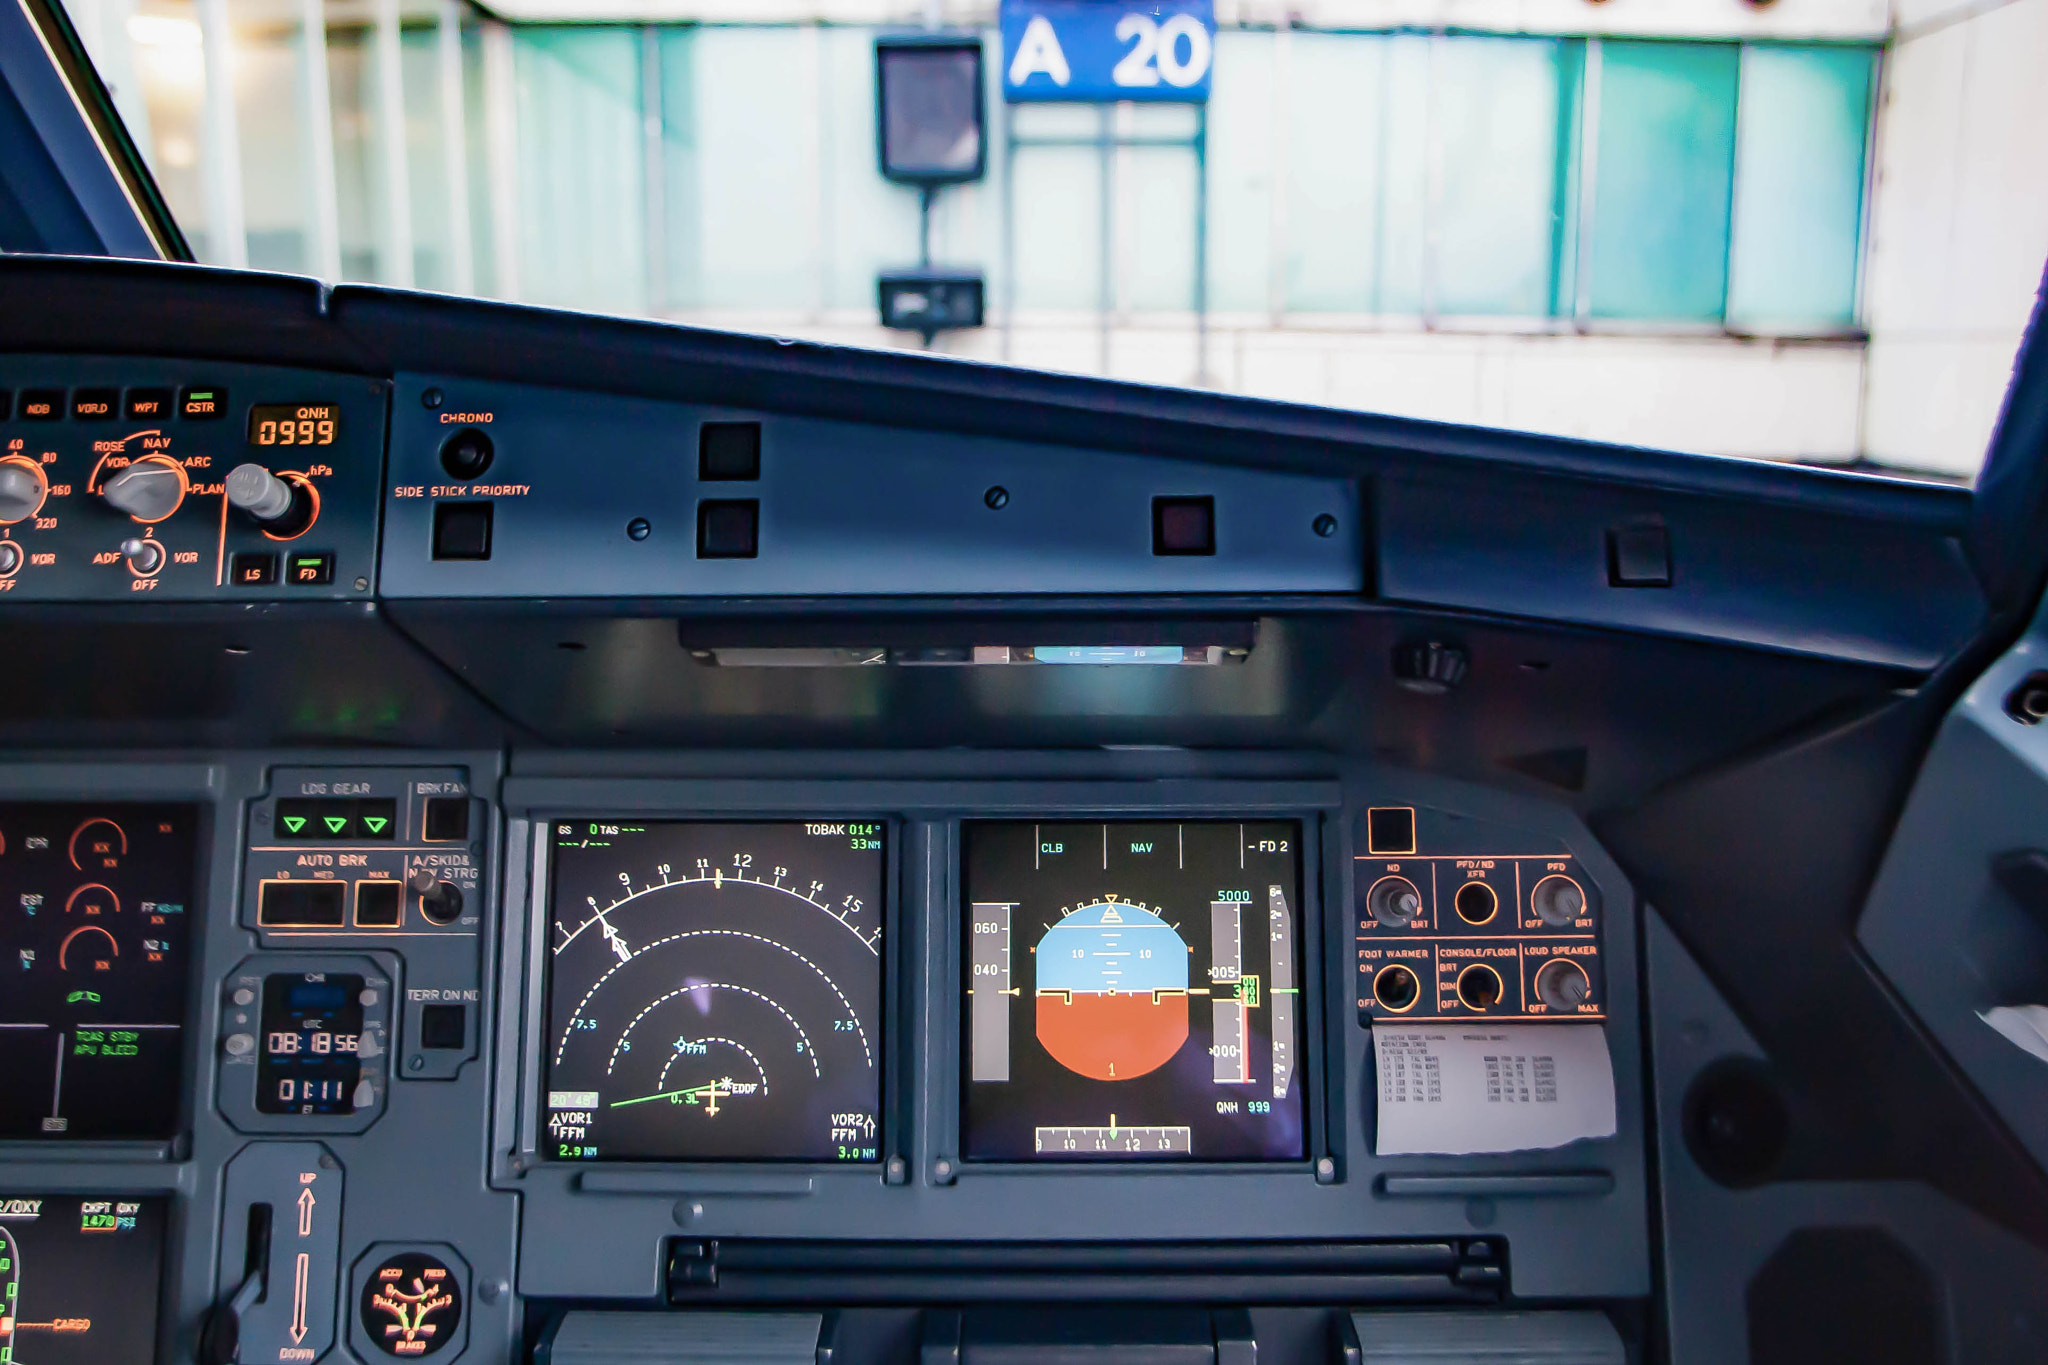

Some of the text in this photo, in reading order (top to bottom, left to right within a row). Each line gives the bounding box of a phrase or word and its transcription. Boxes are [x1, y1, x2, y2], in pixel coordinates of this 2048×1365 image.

[1009, 14, 1212, 87] A 20
[133, 402, 158, 412] WPT
[185, 402, 215, 413] CSTR
[297, 408, 329, 420] QNH
[440, 412, 494, 424] CHRONO
[259, 421, 334, 445] 0999
[8, 439, 23, 449] 40
[94, 441, 125, 451] ROSE
[143, 438, 171, 448] NAV
[106, 458, 129, 468] VOR
[184, 457, 211, 467] ARC
[310, 464, 333, 476] hPa
[51, 485, 71, 495] 160
[192, 484, 225, 494] PLAN
[394, 485, 531, 498] SIDE STICK PRIORITY
[35, 518, 57, 529] 320
[145, 527, 153, 538] 2
[31, 553, 55, 565] VOR
[92, 552, 122, 564] ADF
[174, 552, 199, 563] VOR
[246, 569, 261, 581] LS
[300, 569, 317, 580] FD
[131, 579, 158, 591] OFF
[301, 783, 370, 795] LDG GEAR
[417, 782, 441, 794] BRK
[600, 825, 619, 835] TAS
[805, 824, 845, 835] TOBAK
[1041, 843, 1063, 853] CLB
[1131, 843, 1153, 853] NAV
[1259, 841, 1288, 852] FD 2
[297, 854, 367, 866] AUTO BRK
[696, 858, 709, 868] 11
[733, 853, 752, 868] 12
[443, 868, 478, 879] STRG
[657, 864, 671, 875] 10
[774, 866, 788, 877] 13
[618, 872, 630, 886] 9
[810, 880, 824, 892] 14
[1217, 890, 1250, 901] 5000
[842, 894, 863, 913] 15
[974, 922, 998, 934] 060
[1360, 921, 1379, 929] OFF
[1411, 920, 1428, 928] BRT
[1525, 920, 1544, 928] OFF
[1575, 919, 1593, 927] BRT
[1072, 949, 1084, 959] 10
[1139, 949, 1151, 959] 10
[1359, 949, 1428, 958] FOOT WARMER
[1440, 948, 1517, 957] CONSOLE/FLOOR
[1525, 946, 1597, 956] LOUD SPEAKER
[974, 964, 998, 976] 040
[1359, 964, 1373, 973] ON
[1439, 963, 1458, 972] BRT
[408, 989, 439, 1001] TERR
[443, 989, 461, 1001] ON
[1358, 999, 1376, 1008] OFF
[1441, 1000, 1459, 1009] OFF
[1528, 1004, 1547, 1013] OFF
[1578, 1004, 1599, 1013] MAX
[623, 1041, 631, 1052] 5
[686, 1045, 707, 1055] FFM
[796, 1042, 804, 1053] 5
[732, 1083, 758, 1094] EDDF
[1216, 1101, 1270, 1113] QNH 999
[560, 1112, 592, 1125] VOR1
[831, 1113, 863, 1127] VOR2
[559, 1127, 585, 1140] FFM
[831, 1128, 857, 1142] FFM
[1064, 1140, 1076, 1150] 10
[1095, 1140, 1107, 1150] 11
[1125, 1139, 1140, 1151] 12
[1158, 1139, 1170, 1150] 13
[862, 1149, 876, 1159] NM
[299, 1172, 317, 1184] UP
[116, 1202, 140, 1213] OXY
[279, 1348, 315, 1360] DOWN
